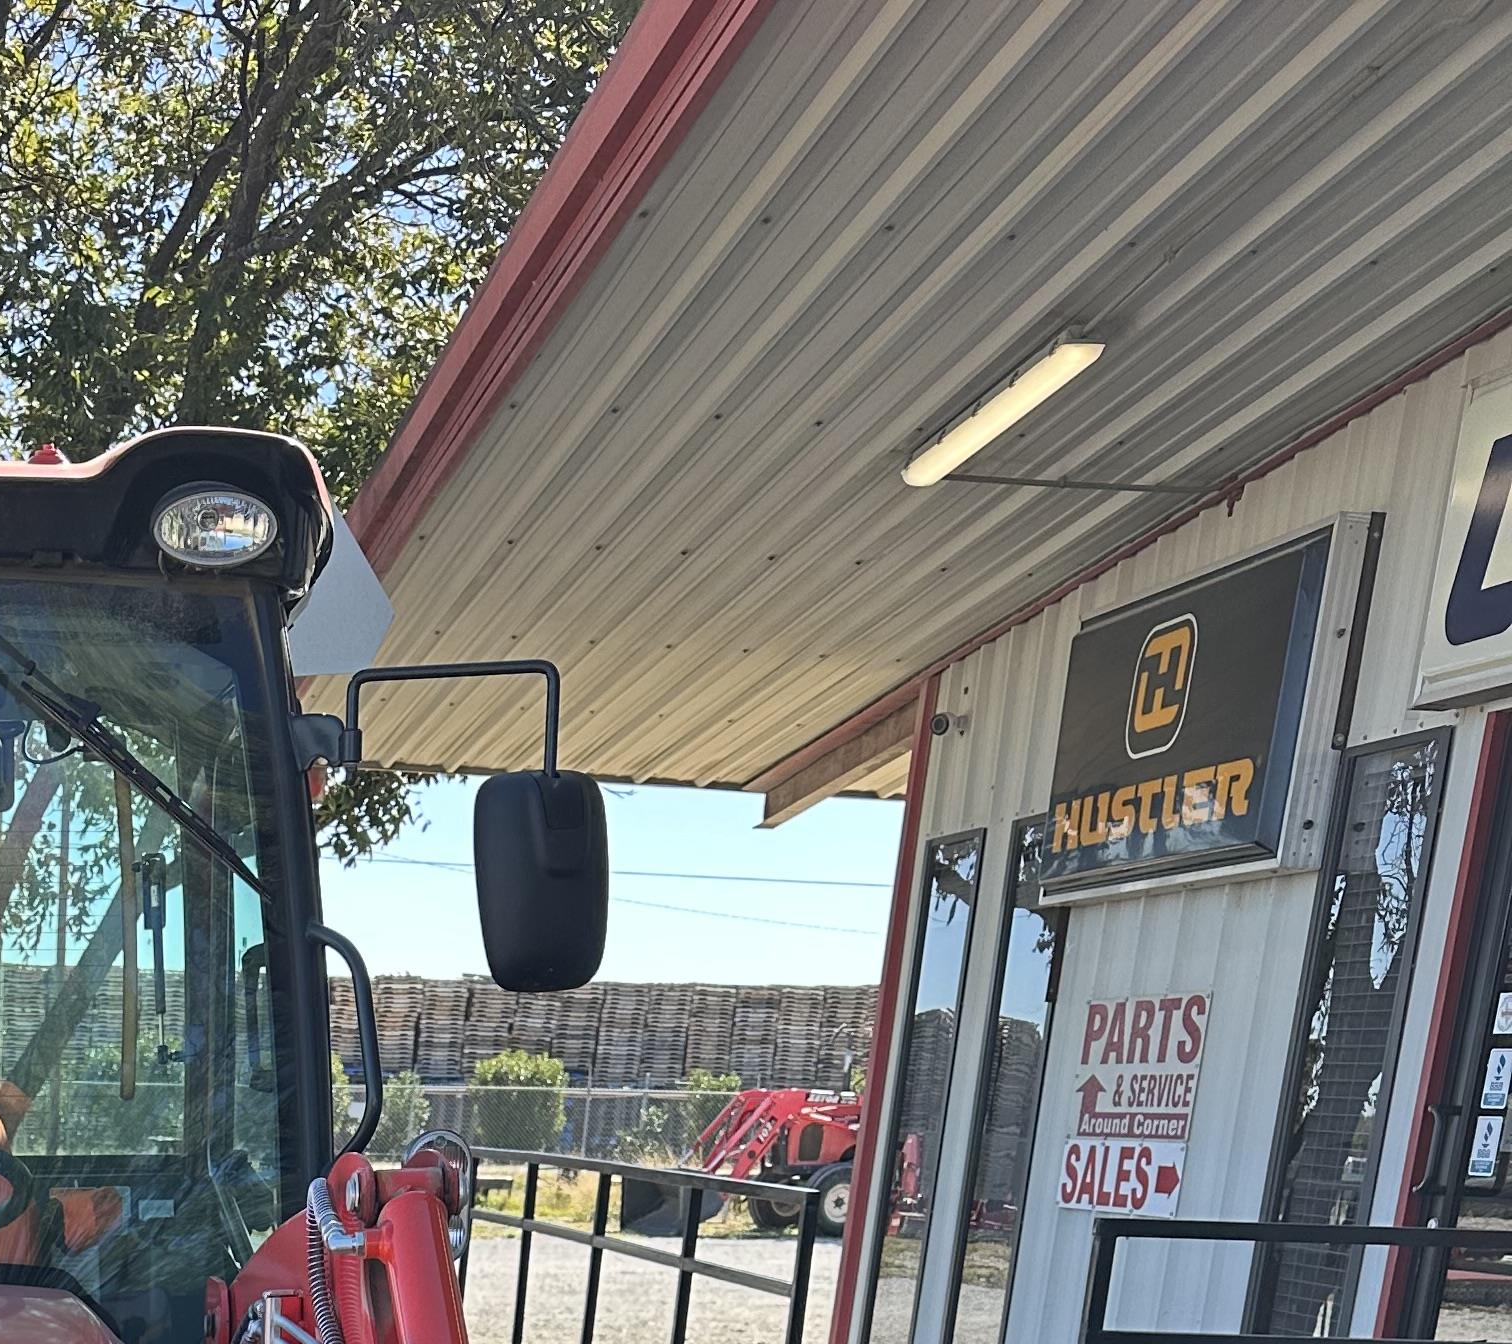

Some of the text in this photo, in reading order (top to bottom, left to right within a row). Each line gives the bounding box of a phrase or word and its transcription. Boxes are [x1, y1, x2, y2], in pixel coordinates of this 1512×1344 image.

[1051, 758, 1255, 853] HUSTLER
[1080, 994, 1207, 1066] PARTS
[1112, 1073, 1195, 1108] & SERVICE
[1080, 1113, 1185, 1136] Around Corner
[1061, 1143, 1152, 1210] SALES
